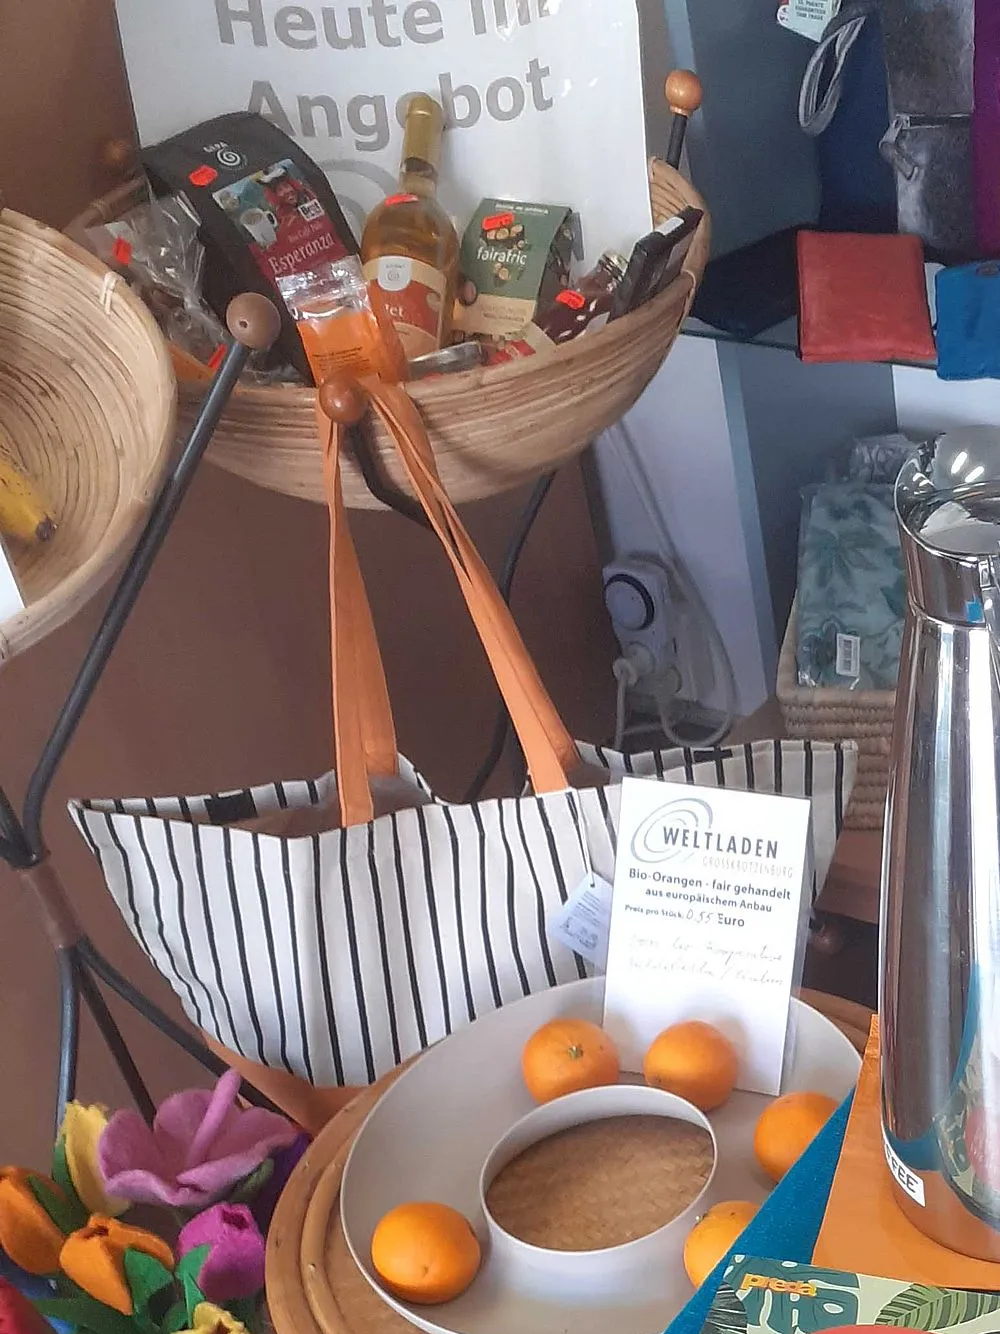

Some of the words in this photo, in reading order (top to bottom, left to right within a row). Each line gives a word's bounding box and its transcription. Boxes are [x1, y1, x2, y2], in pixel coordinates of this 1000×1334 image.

[214, 0, 444, 50] Heute
[268, 231, 335, 275] Esperanza
[477, 247, 527, 265] fairafric
[662, 825, 779, 860] WELTLADEN
[629, 867, 703, 888] Bio-Orangen
[712, 879, 731, 892] fair
[734, 883, 791, 900] gehandelt
[645, 888, 663, 898] aus
[666, 890, 737, 908] europäischem
[740, 899, 772, 913] Anbau
[718, 912, 745, 928] Euro
[740, 1273, 818, 1297] preda
